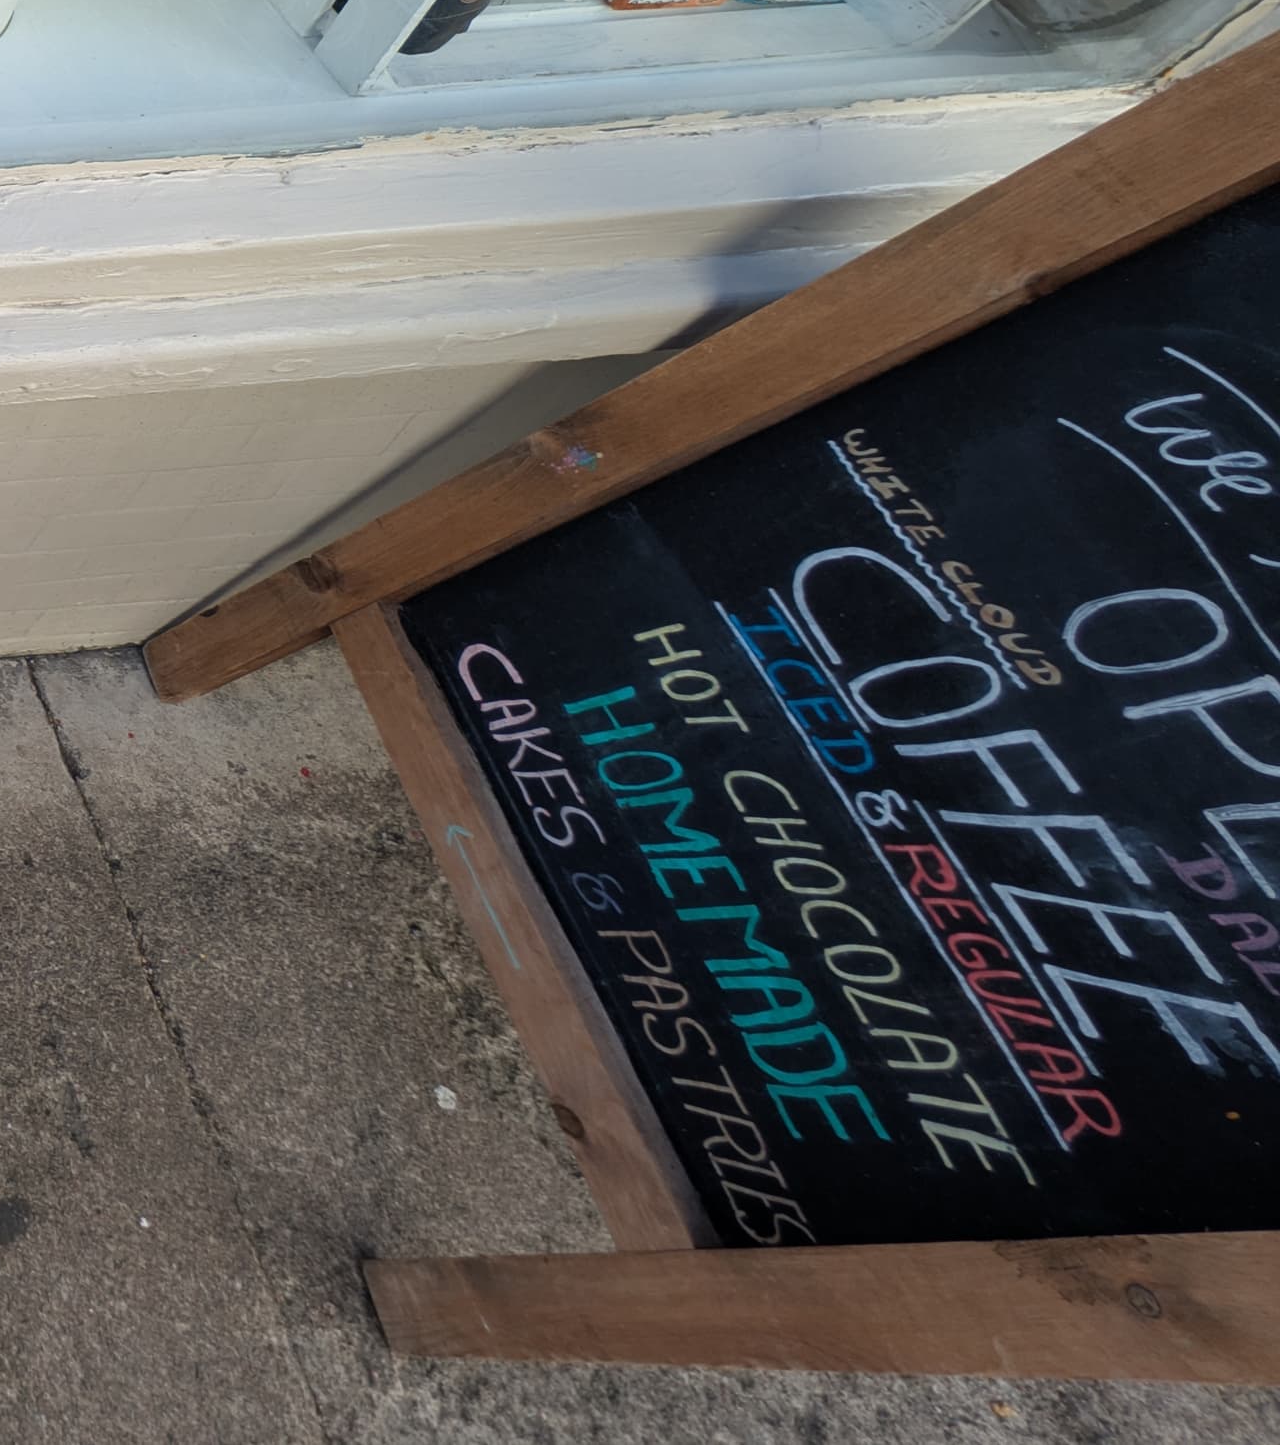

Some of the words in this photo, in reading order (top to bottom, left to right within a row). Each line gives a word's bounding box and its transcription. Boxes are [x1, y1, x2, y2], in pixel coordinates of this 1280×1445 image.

[792, 545, 1280, 1076] COFFEE
[842, 427, 945, 547] WHITE
[941, 560, 1062, 686] CLOUD
[457, 642, 607, 848] CAKES
[596, 929, 817, 1245] PASTRIES
[563, 685, 892, 1143] HOMEMADE
[633, 623, 750, 733] HOT
[723, 769, 1037, 1186] CHOCOLATE
[729, 605, 876, 775] ICED
[854, 788, 910, 830] &
[886, 842, 1122, 1142] REGULAR
